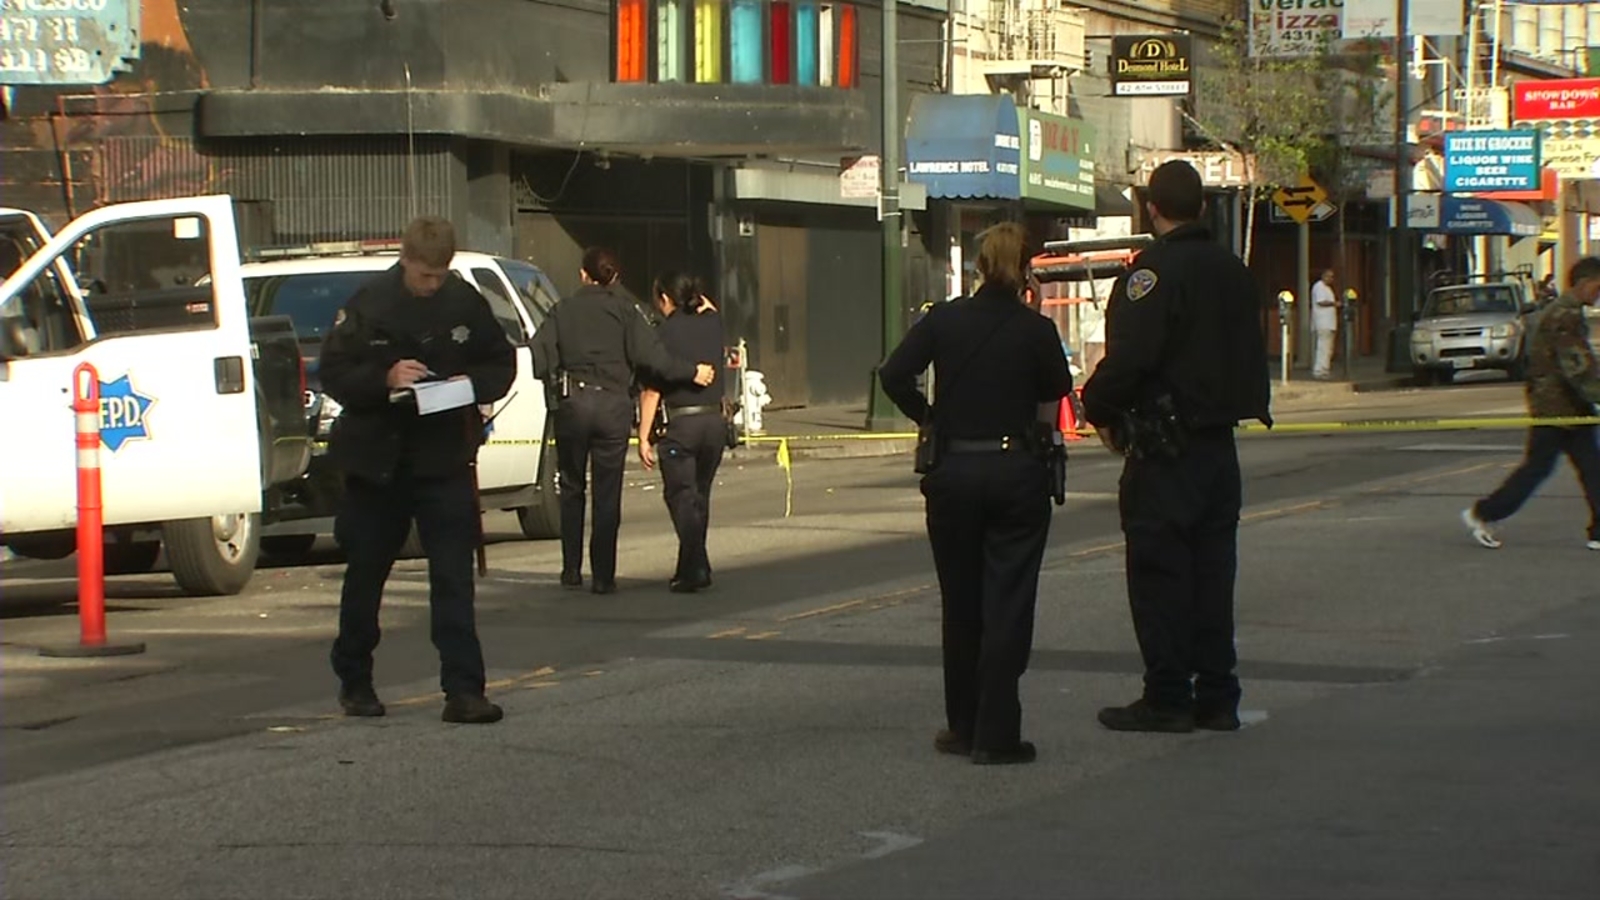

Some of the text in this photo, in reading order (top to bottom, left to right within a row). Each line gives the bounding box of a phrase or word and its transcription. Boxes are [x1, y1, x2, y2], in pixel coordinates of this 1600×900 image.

[1253, 11, 1339, 30] Pizza
[1147, 43, 1161, 57] D
[1450, 155, 1534, 165] LIQUOR WINE
[909, 161, 959, 173] LAWRENCE
[960, 160, 990, 173] HOTEL
[1475, 166, 1508, 175] BEER
[1455, 176, 1528, 187] CIGARETTE
